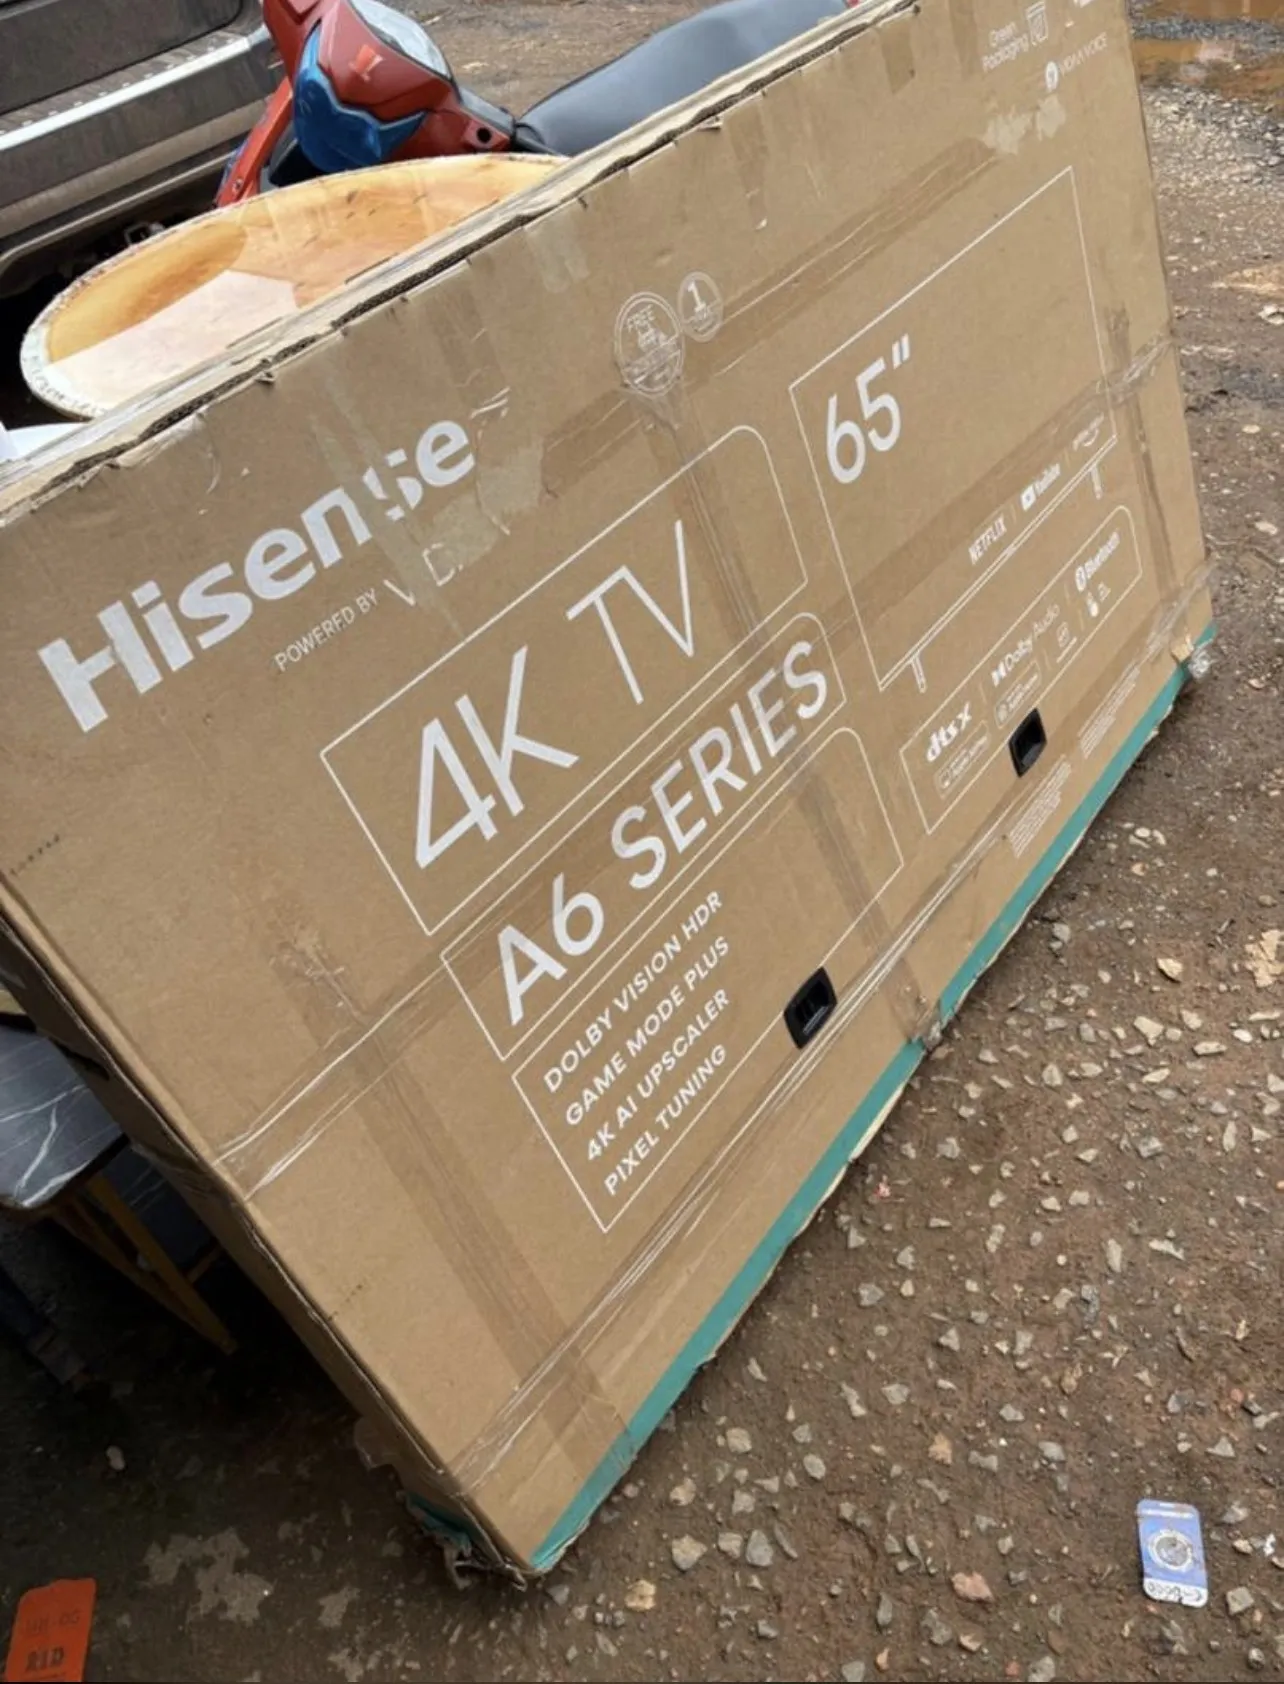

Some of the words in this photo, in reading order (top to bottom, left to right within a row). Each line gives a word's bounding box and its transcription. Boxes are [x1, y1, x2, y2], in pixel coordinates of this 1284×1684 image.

[38, 421, 475, 732] Hisense
[274, 606, 355, 671] POWERED
[356, 588, 377, 613] BY
[968, 515, 1007, 565] NETFLIX
[415, 644, 579, 869] 4K
[566, 520, 694, 704] TV
[1004, 636, 1033, 672] Dolby
[1032, 603, 1060, 642] Audio
[498, 872, 604, 1026] A6
[611, 641, 828, 889] SERIES
[543, 1008, 613, 1093] DOLBY
[613, 934, 683, 1012] VISION
[681, 891, 723, 940] HDR
[566, 1052, 628, 1125] GAME
[626, 986, 685, 1057] MODE
[683, 936, 730, 991] PLUS
[588, 1122, 616, 1160] 4K
[616, 1096, 638, 1128] AI
[636, 988, 730, 1098] UPSCALER
[604, 1130, 659, 1196] PIXEL
[656, 1044, 727, 1130] TUNING
